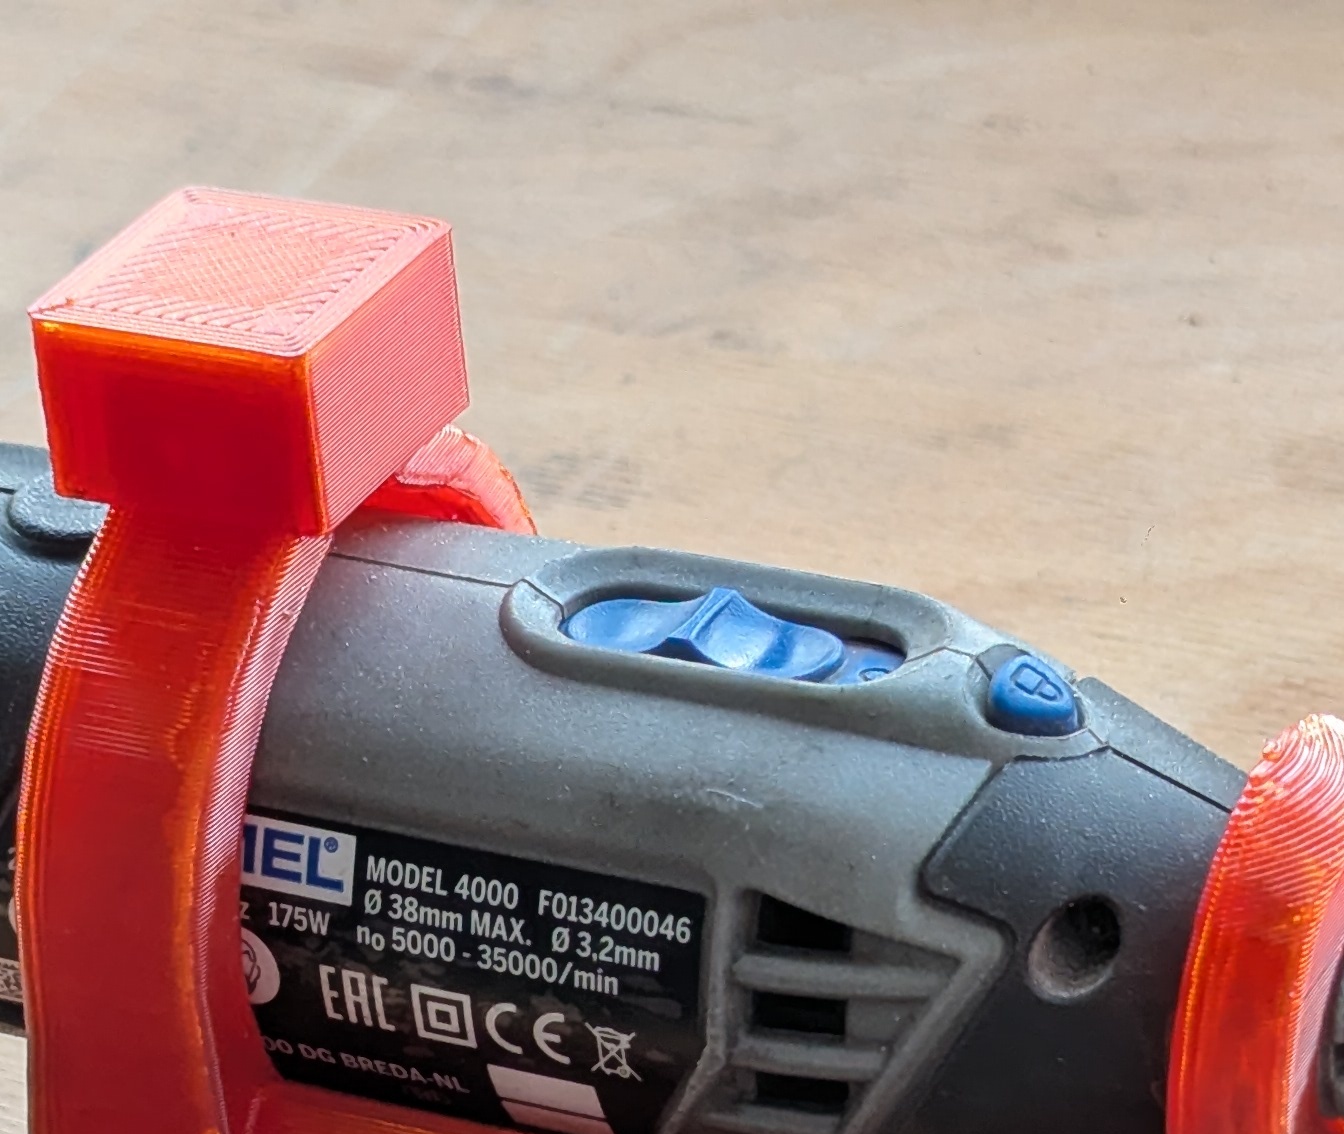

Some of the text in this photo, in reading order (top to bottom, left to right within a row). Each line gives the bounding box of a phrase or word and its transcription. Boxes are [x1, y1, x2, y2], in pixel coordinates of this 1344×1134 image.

[269, 901, 330, 936] 175W
[364, 889, 382, 914] Ø
[388, 893, 463, 932] 38mm
[470, 910, 532, 946] MAX.
[551, 926, 570, 952] Ø
[367, 855, 691, 943] MODEL 4000 F013400046
[392, 926, 455, 962] 5000
[477, 944, 618, 996] 35000/min
[319, 964, 396, 1031] EAC
[485, 1003, 571, 1064] CE
[298, 1043, 336, 1064] DG
[339, 1051, 471, 1093] BREDA-NL
